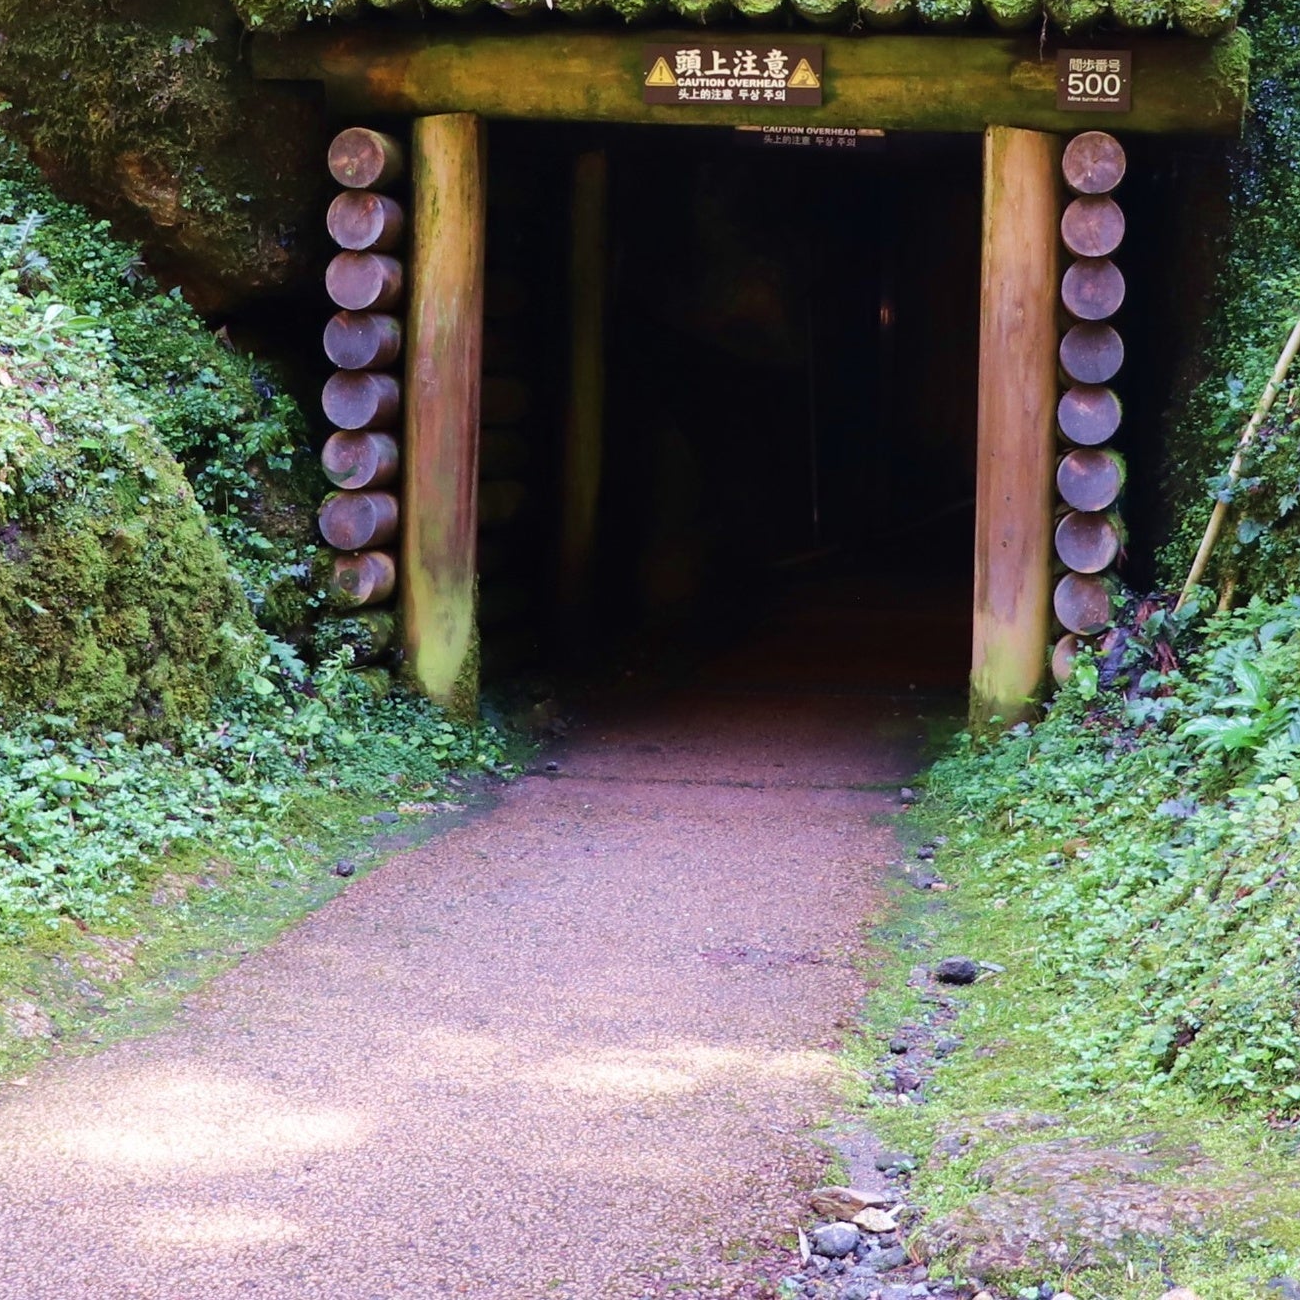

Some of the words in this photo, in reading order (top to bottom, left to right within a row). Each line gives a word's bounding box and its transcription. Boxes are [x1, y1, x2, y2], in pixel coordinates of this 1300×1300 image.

[675, 49, 789, 78] 頭上注意
[1069, 58, 1120, 72] 間歩番号
[677, 78, 725, 88] CAUTION
[727, 78, 786, 88] OVERHEAD
[1068, 74, 1120, 95] 500
[678, 89, 734, 101] 头上的注意
[738, 90, 760, 101] 두상
[763, 90, 786, 102] 주의
[763, 125, 804, 135] CAUTION
[806, 126, 856, 137] OVERHEAD
